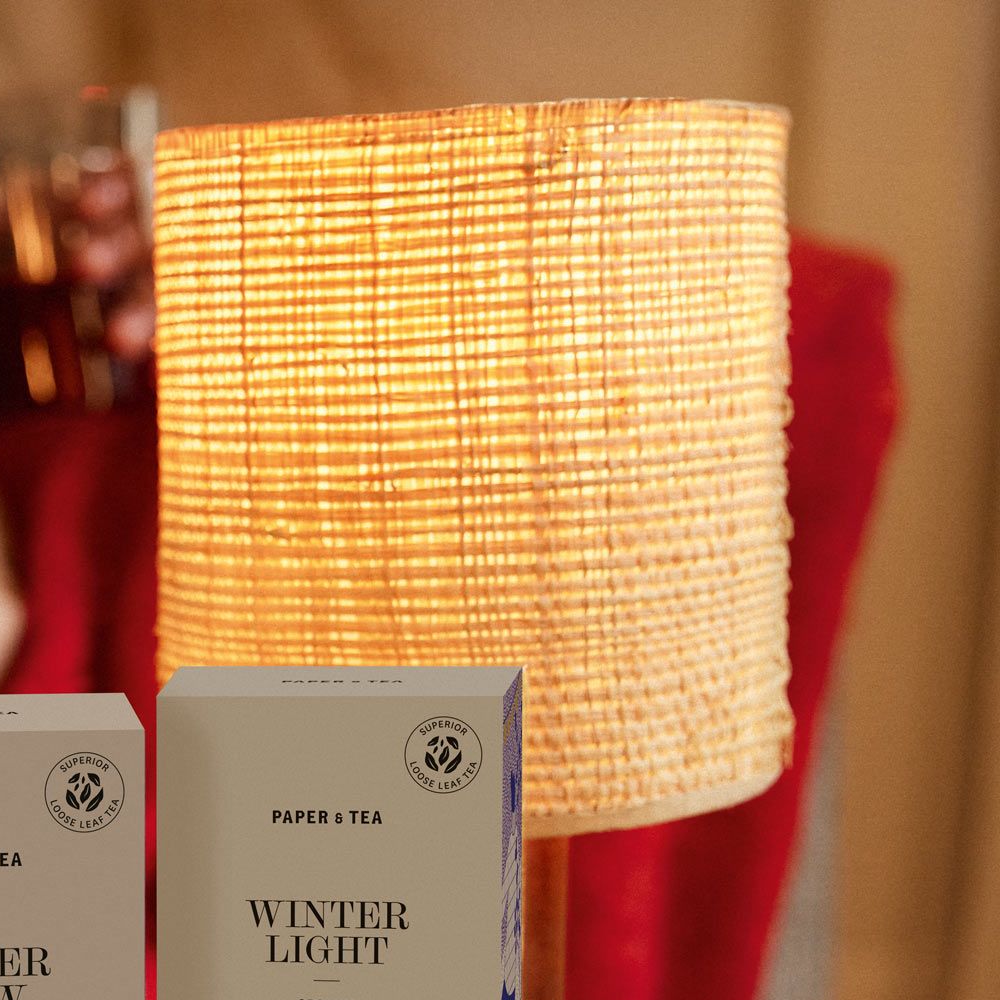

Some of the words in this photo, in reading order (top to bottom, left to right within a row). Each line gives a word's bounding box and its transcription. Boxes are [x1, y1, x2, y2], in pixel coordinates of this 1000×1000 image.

[419, 721, 468, 737] SUPERIOR
[59, 756, 110, 772] SUPERIOR
[409, 760, 435, 789] LOOSE
[438, 778, 462, 790] LEAF
[462, 761, 477, 779] TEA
[50, 799, 76, 827] LOOSE
[79, 816, 105, 828] LEAF
[104, 798, 120, 818] TEA
[272, 810, 328, 824] PAPER
[335, 812, 343, 825] &
[349, 810, 382, 825] TEA
[246, 899, 409, 930] WINTER
[265, 934, 388, 965] LIGHT
